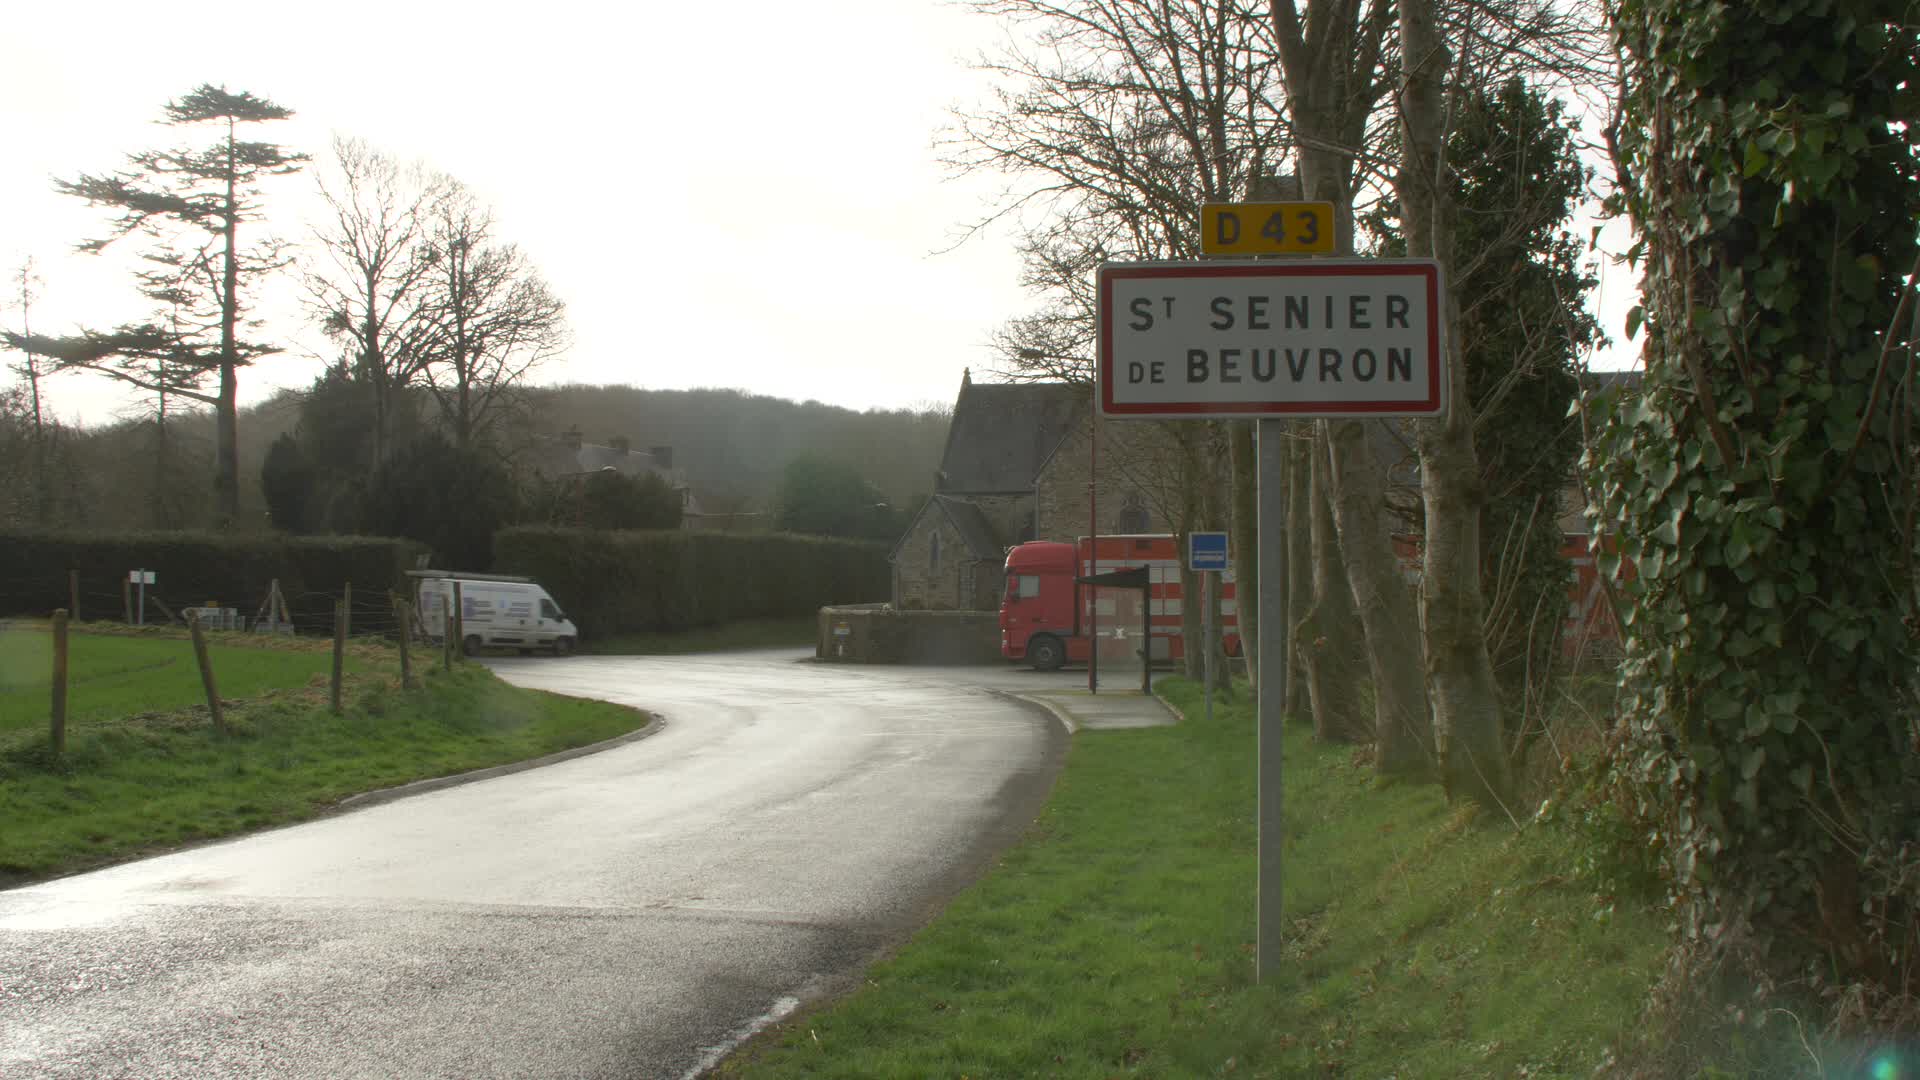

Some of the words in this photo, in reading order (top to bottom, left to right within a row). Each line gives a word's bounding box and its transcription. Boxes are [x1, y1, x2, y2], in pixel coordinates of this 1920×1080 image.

[1216, 211, 1241, 245] D
[1259, 210, 1319, 245] 43
[1209, 295, 1410, 331] SENIER
[1128, 360, 1165, 384] DE
[1186, 347, 1412, 383] BEUVRON
